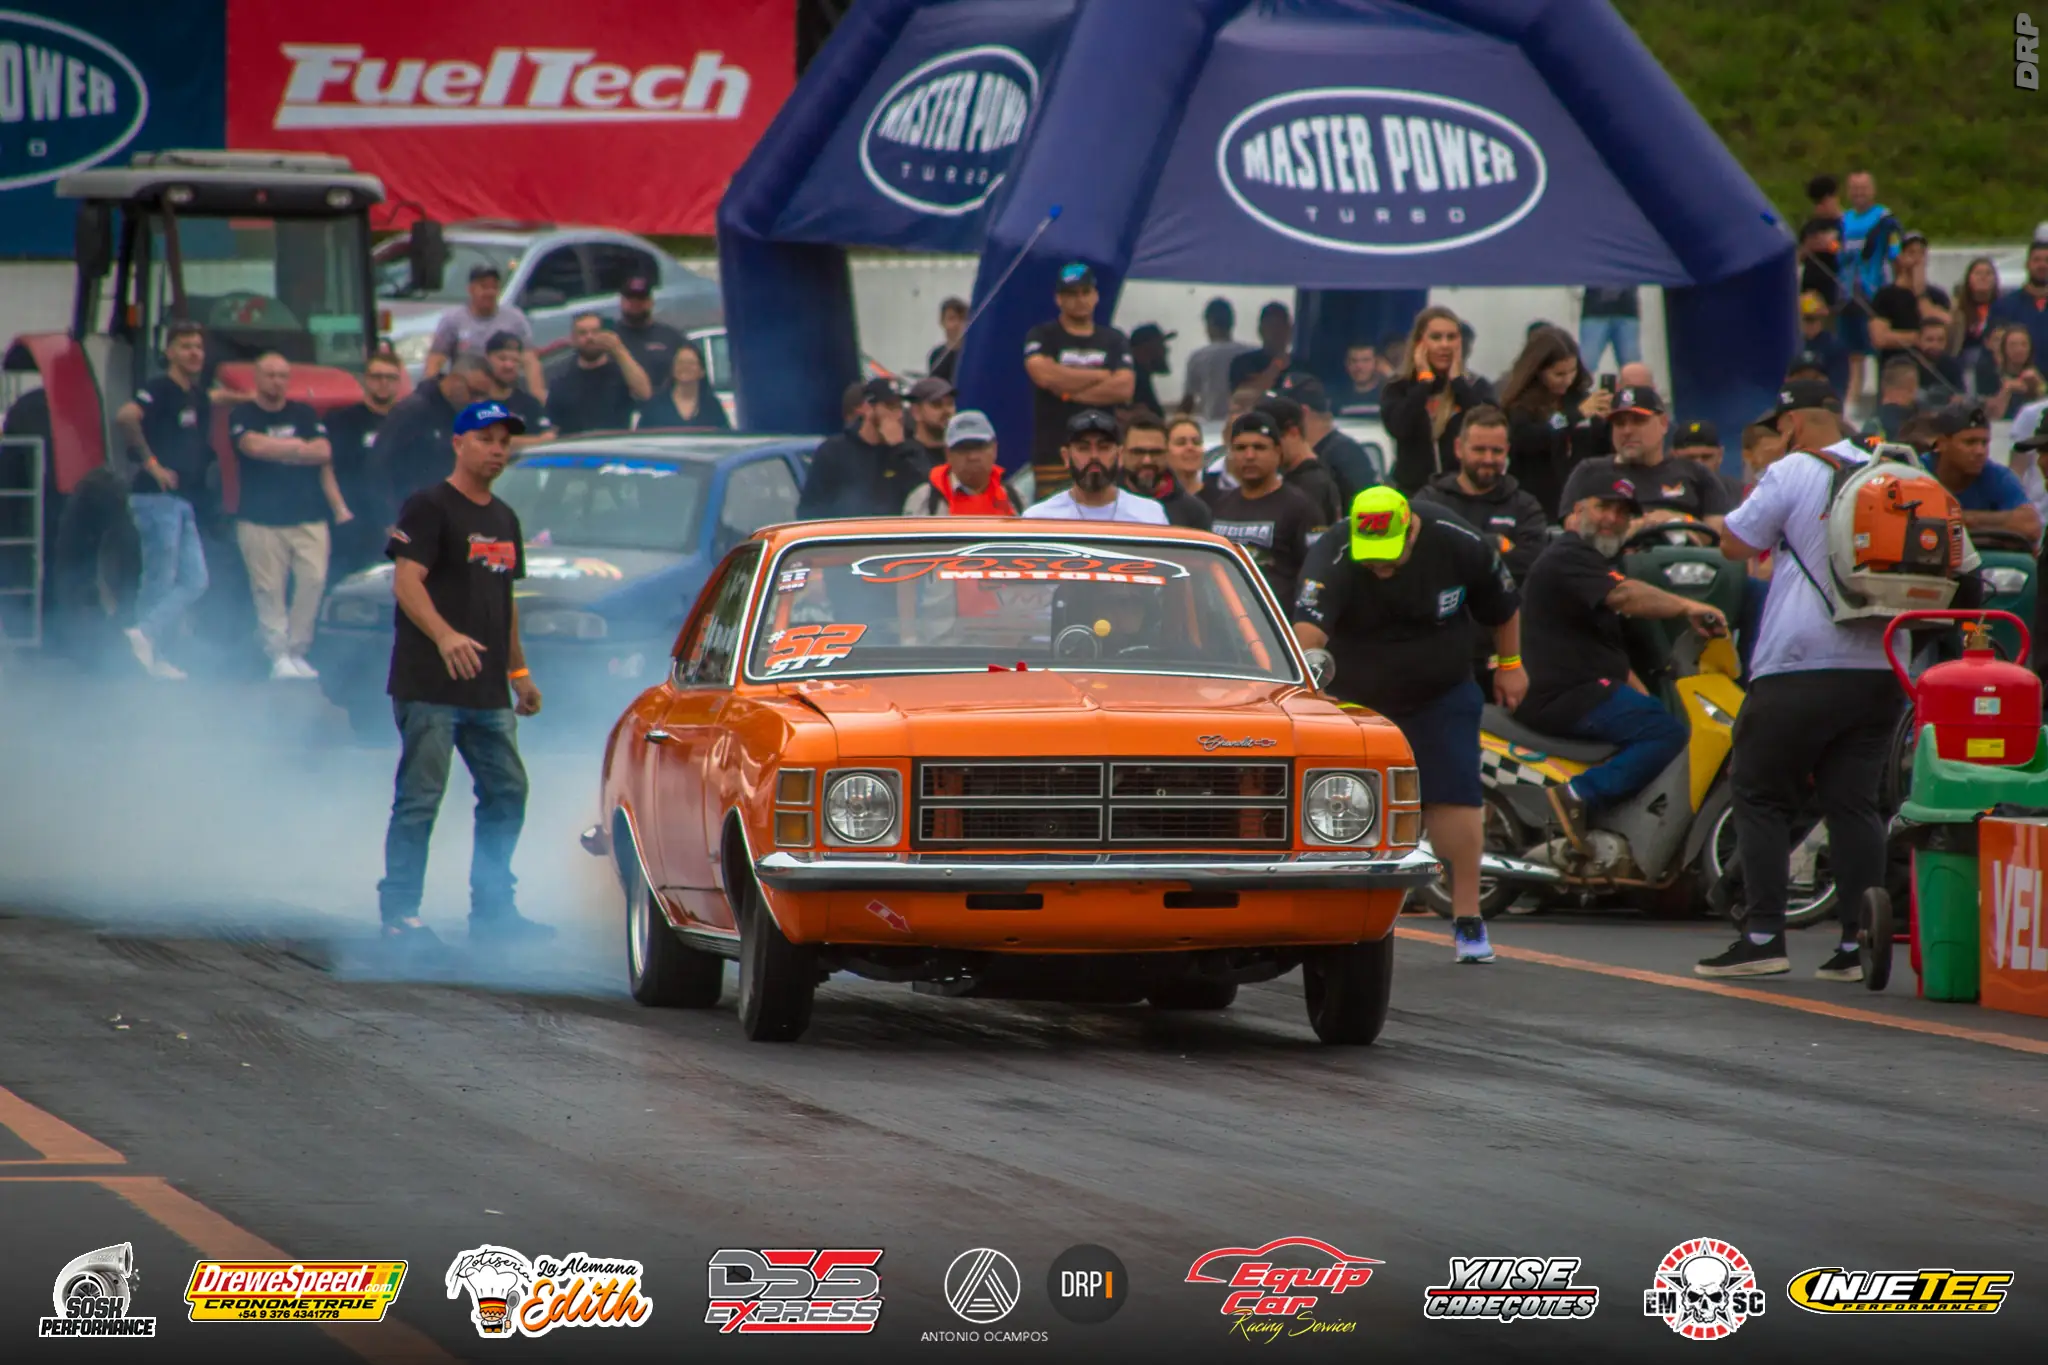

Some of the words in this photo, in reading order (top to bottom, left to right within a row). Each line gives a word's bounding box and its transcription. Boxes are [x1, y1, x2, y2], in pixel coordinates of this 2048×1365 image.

[274, 43, 751, 121] FuelTech
[877, 70, 977, 151] MASTER
[1242, 114, 1379, 193] MASTER
[1381, 114, 1518, 193] POWER
[1305, 206, 1466, 223] TURBO
[937, 569, 1167, 585] MOTORS
[764, 654, 848, 676] STT
